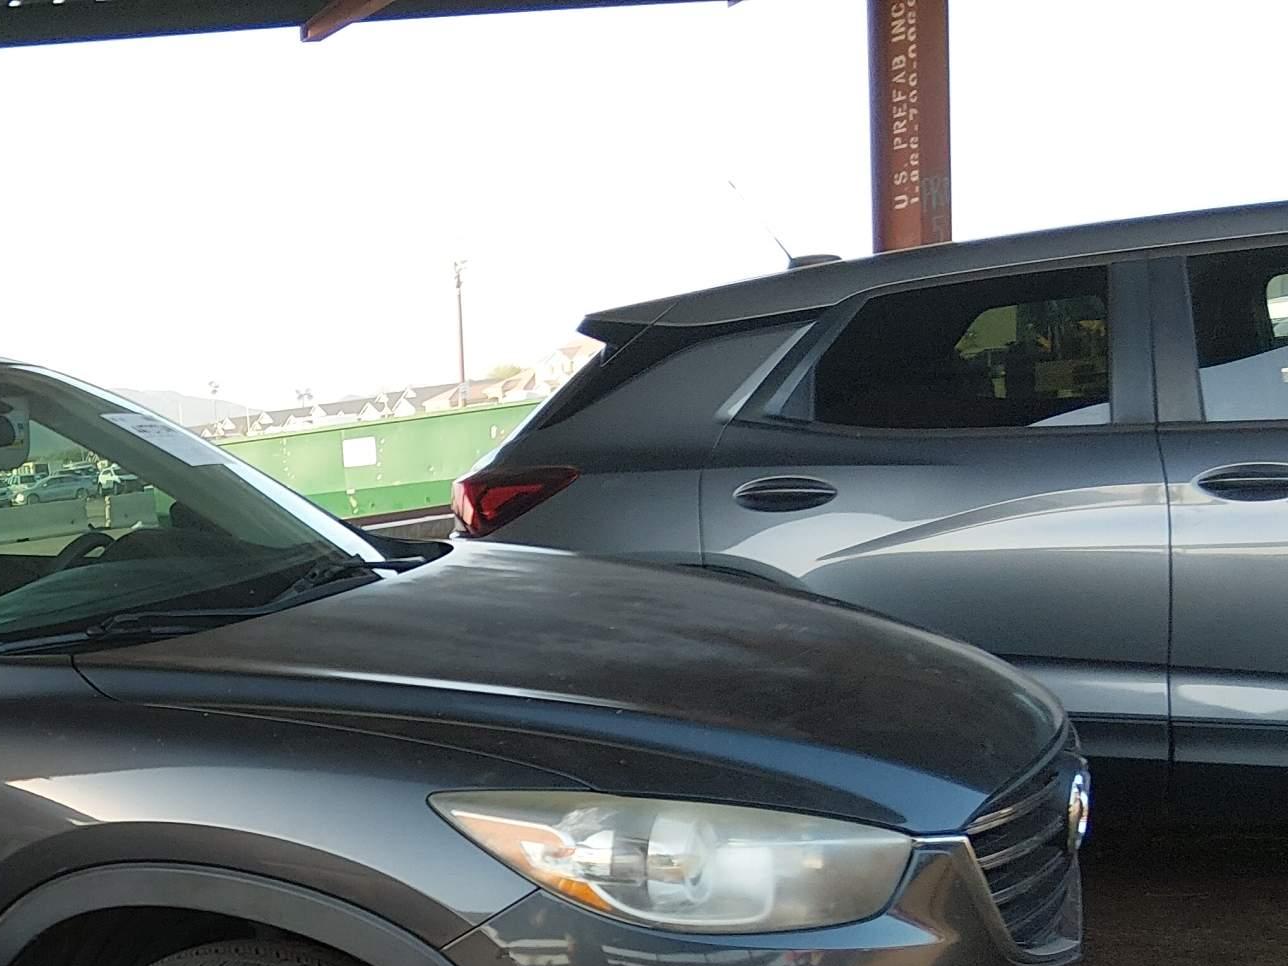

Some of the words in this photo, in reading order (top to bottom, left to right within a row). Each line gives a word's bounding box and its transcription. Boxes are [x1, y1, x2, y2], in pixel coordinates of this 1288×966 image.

[891, 2, 906, 42] INC
[893, 54, 908, 150] PREFAB
[894, 163, 909, 210] U.S.
